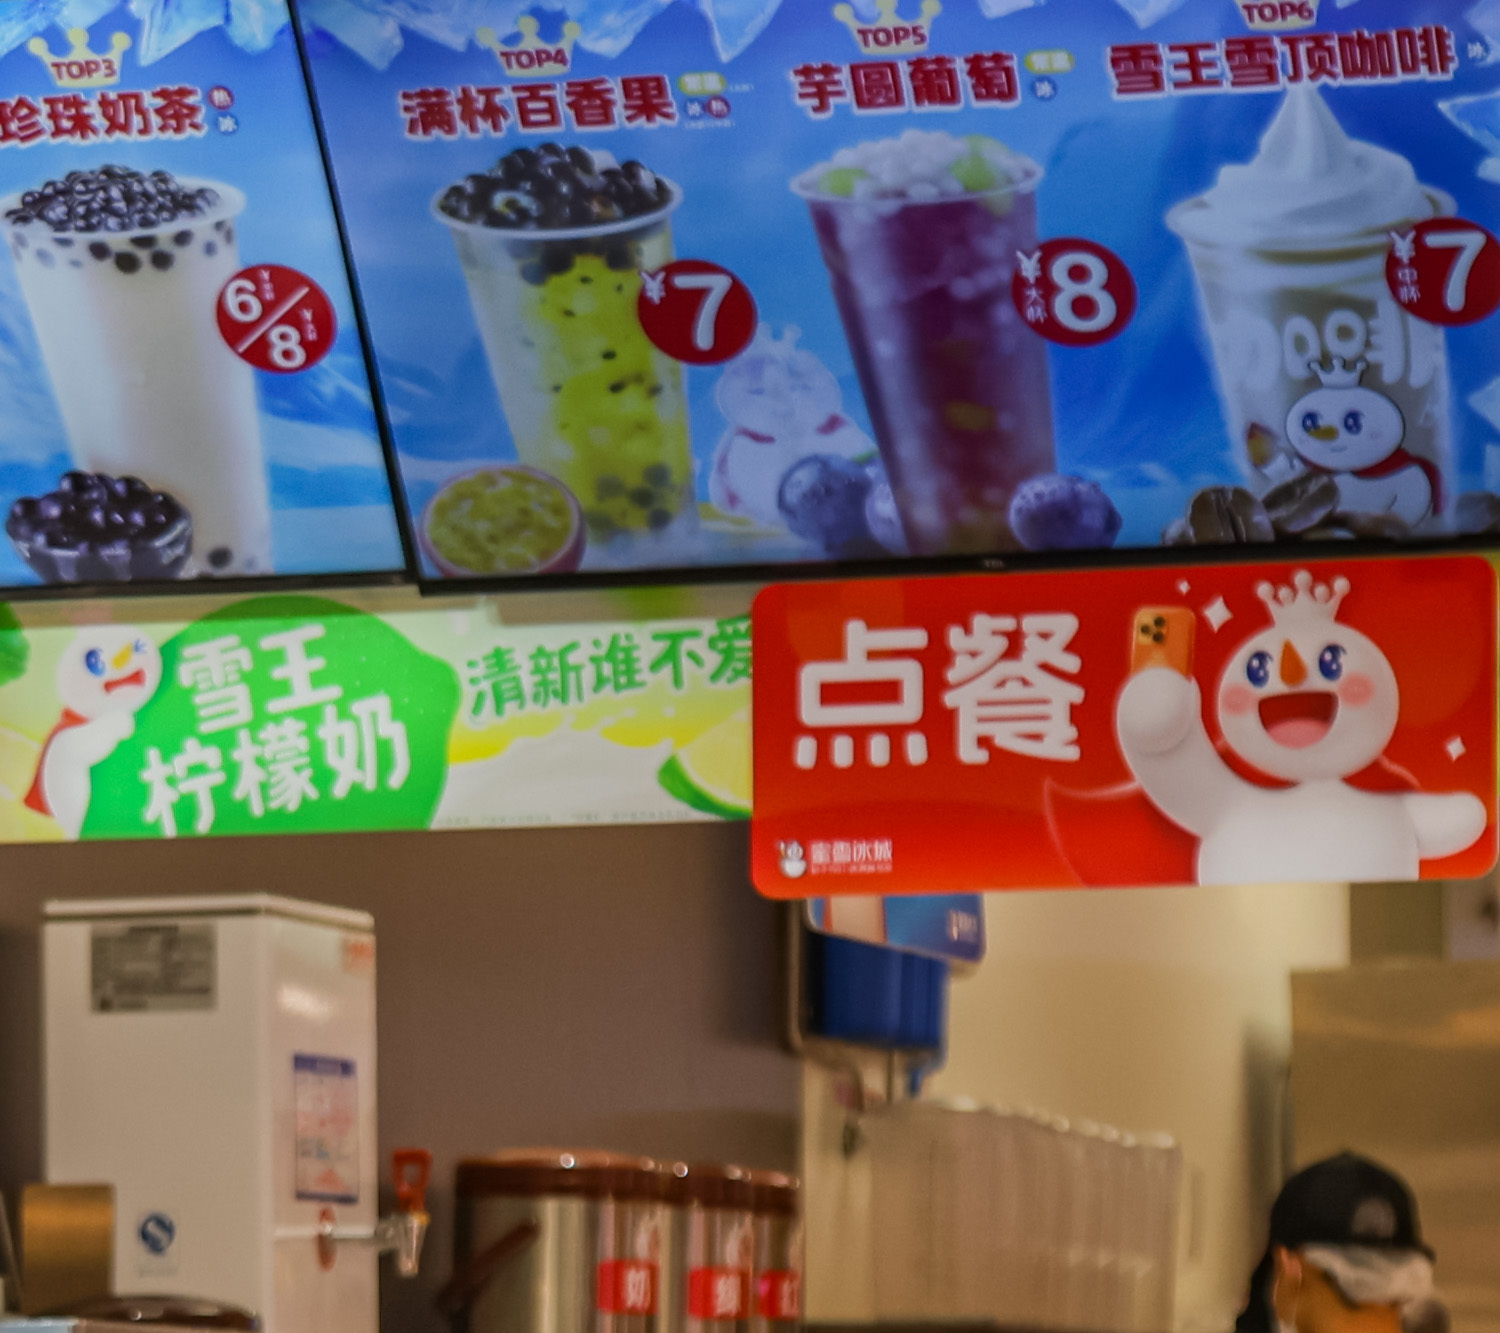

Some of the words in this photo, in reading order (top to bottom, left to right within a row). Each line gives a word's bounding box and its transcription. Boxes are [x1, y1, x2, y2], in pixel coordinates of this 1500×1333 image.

[857, 23, 929, 51] TOP5
[1241, 1, 1316, 25] TOP6
[50, 56, 118, 83] TOP3
[498, 45, 569, 72] TOP4
[793, 52, 1018, 116] 芋圆葡萄
[1107, 23, 1457, 97] 雪王雪顶咖啡
[400, 74, 678, 139] 满杯百香果
[177, 624, 343, 735] 雪王
[792, 613, 1085, 770] 点餐
[143, 694, 412, 838] 柠檬奶
